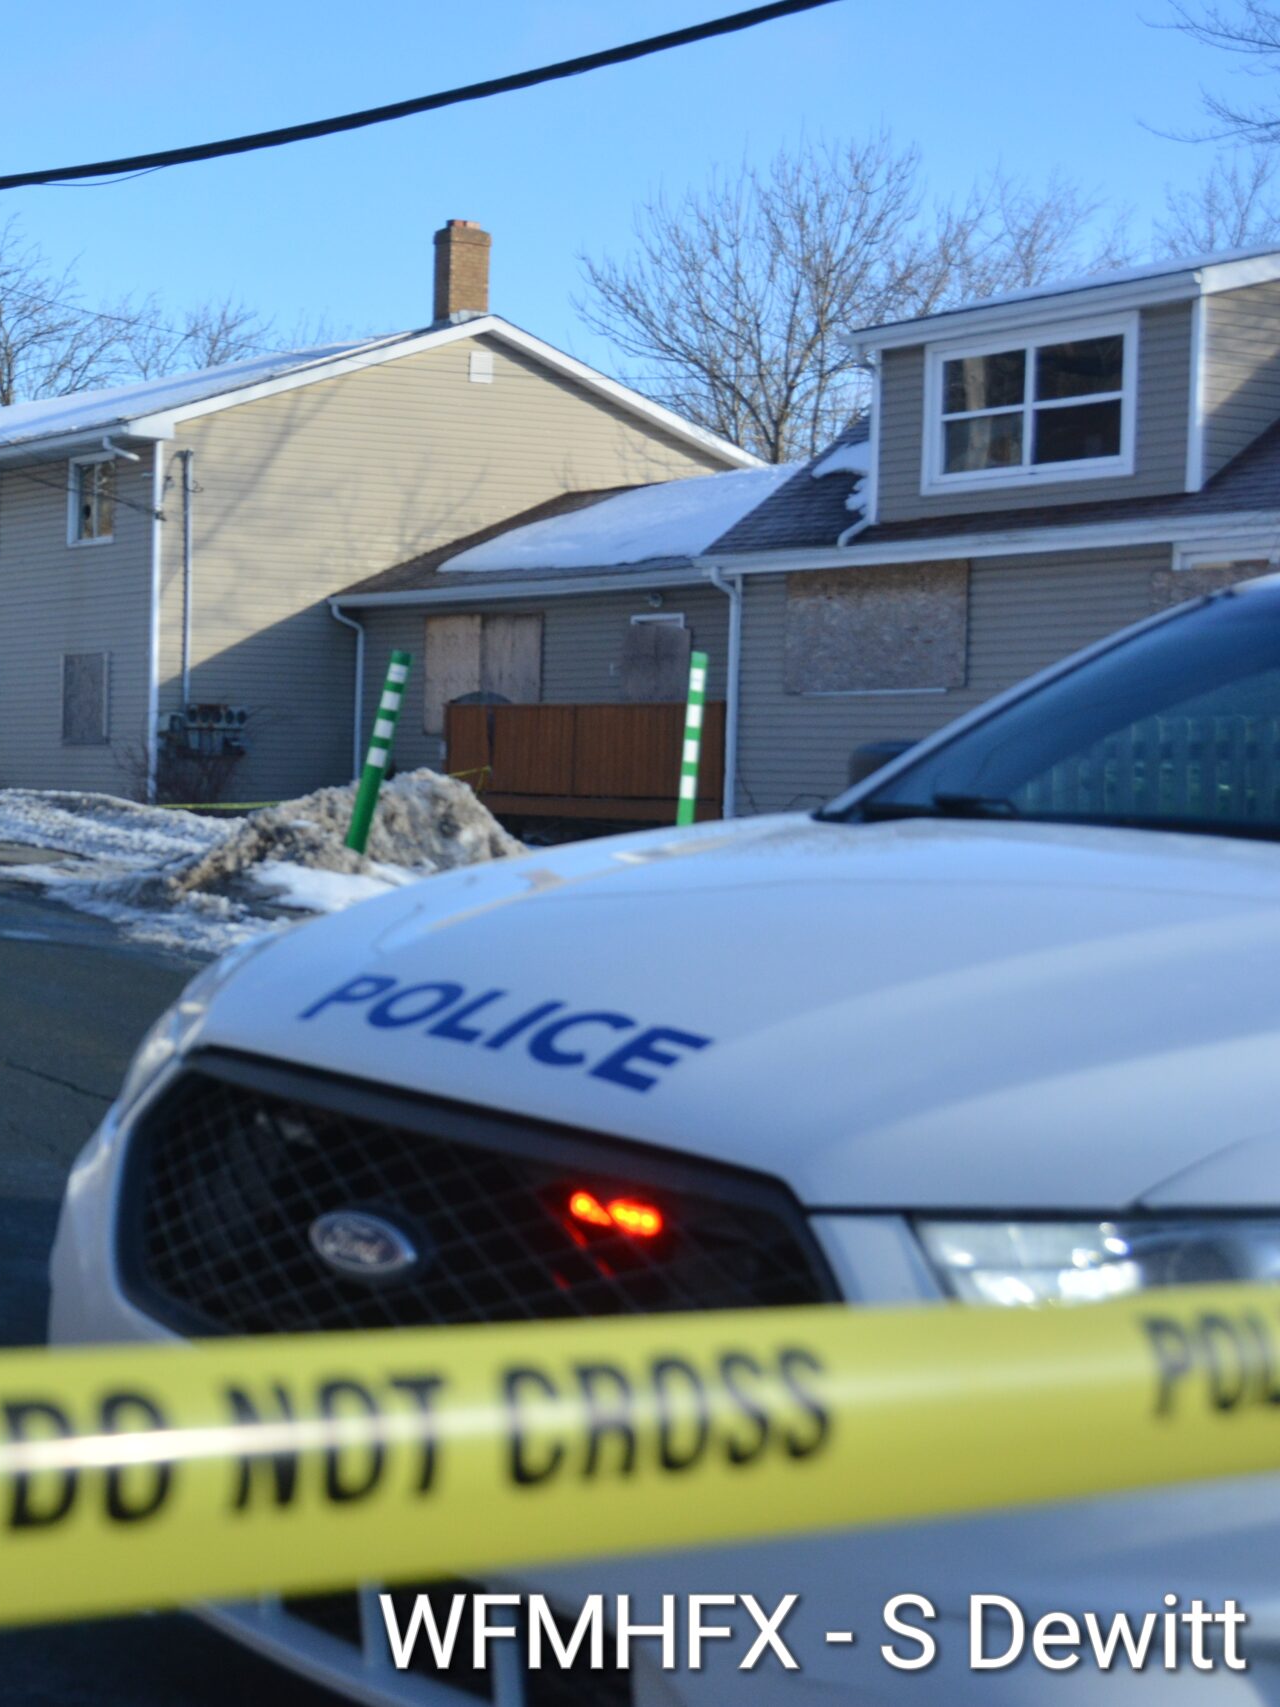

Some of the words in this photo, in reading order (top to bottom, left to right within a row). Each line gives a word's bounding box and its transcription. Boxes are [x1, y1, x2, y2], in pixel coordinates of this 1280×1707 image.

[297, 973, 713, 1093] POLICE
[4, 1393, 174, 1531] DO
[228, 1374, 447, 1510] NOT
[498, 1348, 832, 1488] CROSS
